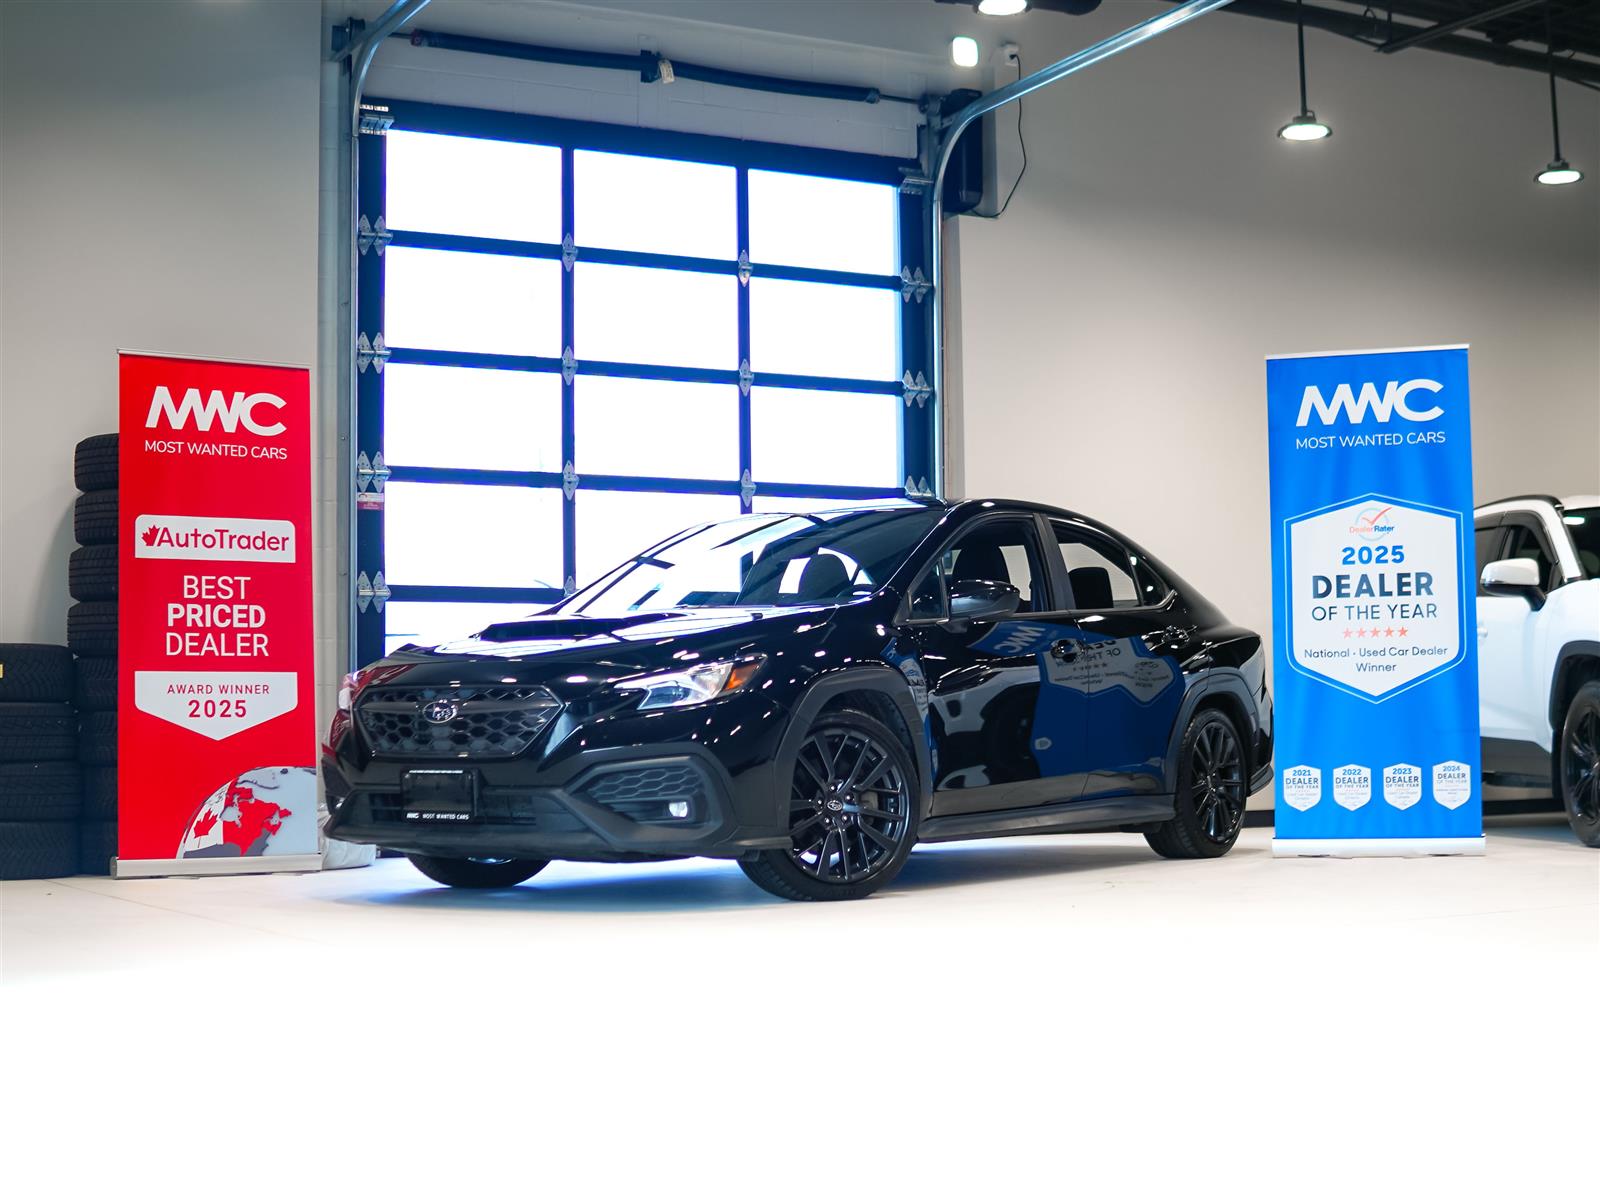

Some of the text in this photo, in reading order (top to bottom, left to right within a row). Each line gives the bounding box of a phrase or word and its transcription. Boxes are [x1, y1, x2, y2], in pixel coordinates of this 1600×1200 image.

[145, 385, 287, 436] MWC
[1296, 378, 1445, 427] MWC
[144, 440, 288, 460] MOST WANTED CARS
[1296, 431, 1446, 450] MOST WANTED CARS
[157, 527, 289, 551] AutoTrader
[1342, 545, 1405, 565] 2025
[183, 575, 251, 600] BEST
[1312, 572, 1434, 599] DEALER
[167, 603, 266, 628] PRICED
[1311, 603, 1438, 621] OF THE YEAR
[165, 632, 269, 657] DEALER
[1304, 646, 1448, 658] National Used Car Dealer
[1355, 663, 1397, 673] Winner
[167, 684, 270, 695] AWARD WINNER
[188, 699, 247, 719] 2025
[1335, 776, 1368, 784] DEALER
